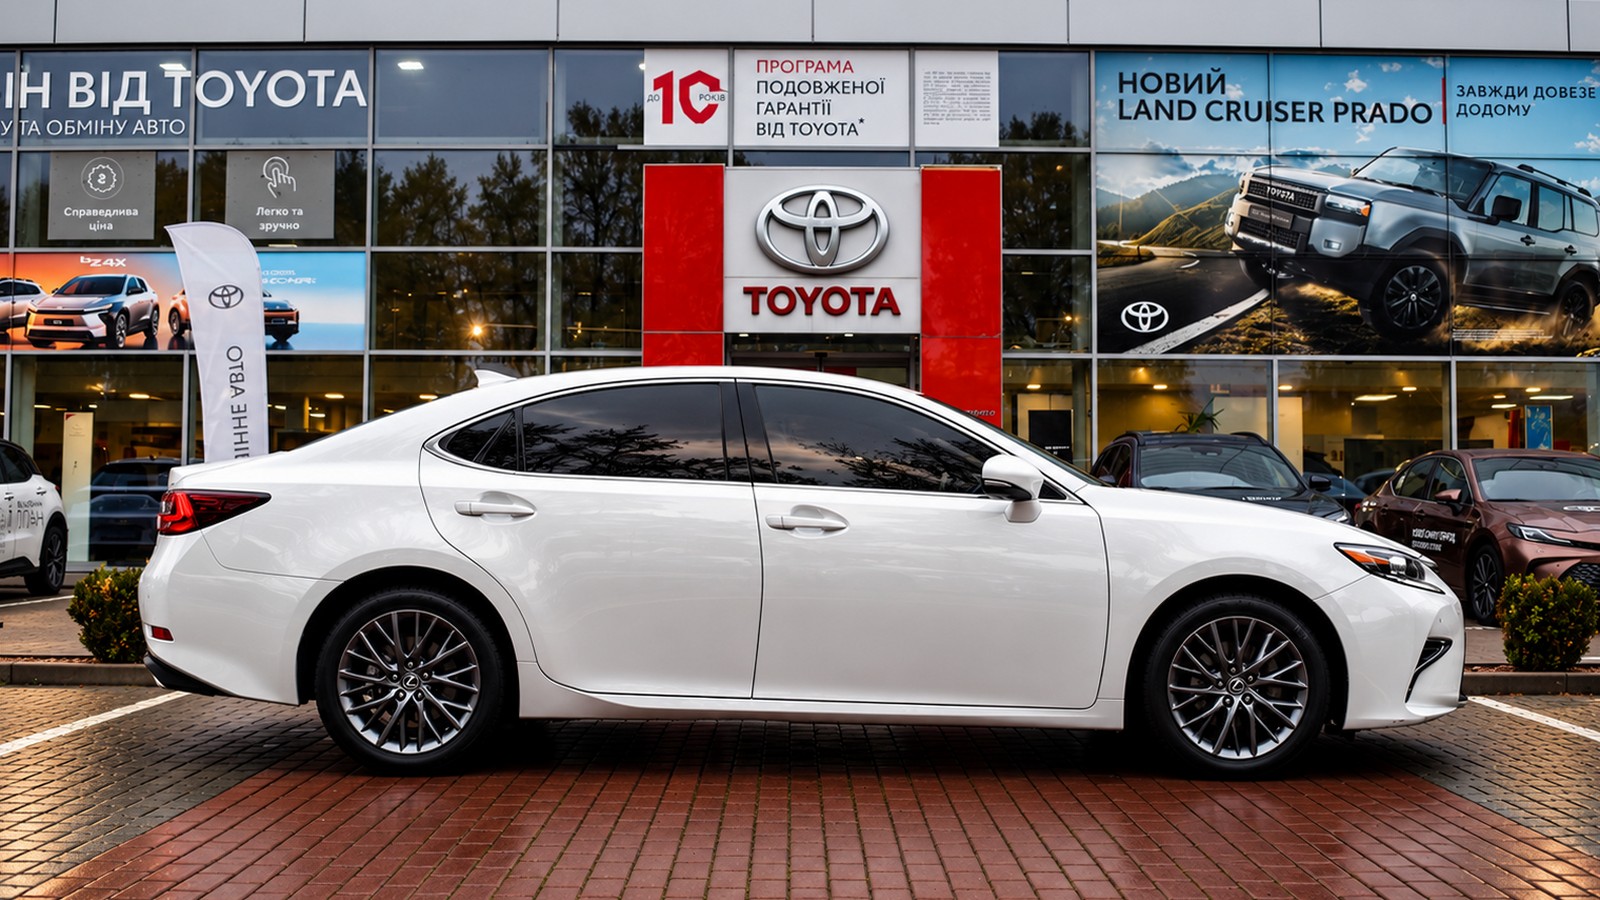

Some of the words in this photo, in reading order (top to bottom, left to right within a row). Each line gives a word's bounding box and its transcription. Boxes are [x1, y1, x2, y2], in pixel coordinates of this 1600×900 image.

[757, 59, 854, 74] ПРОГРАМА
[757, 77, 886, 97] ПОДОВЖЕНОЇ
[1118, 67, 1226, 95] НОВИЙ
[68, 71, 151, 116] ВІД
[164, 69, 367, 108] TOYOTA
[1456, 85, 1528, 100] ЗАВЖДИ
[1533, 86, 1596, 100] ДОВЕЗЕ
[757, 99, 831, 115] ГАРАНТІЇ
[1118, 98, 1197, 121] LAND
[1205, 100, 1325, 123] CRUISER
[1334, 102, 1433, 124] PRADO
[1456, 103, 1531, 117] ДОДОМУ
[20, 120, 41, 135] ТА
[46, 119, 127, 136] ОБМІНУ
[132, 119, 186, 135] АВТО
[757, 122, 785, 138] ВІД
[63, 206, 139, 218] Справедлива
[256, 206, 289, 216] Легко
[291, 208, 304, 216] та
[89, 220, 113, 231] ціна
[259, 222, 300, 232] зручно
[743, 286, 901, 316] TOYOTA
